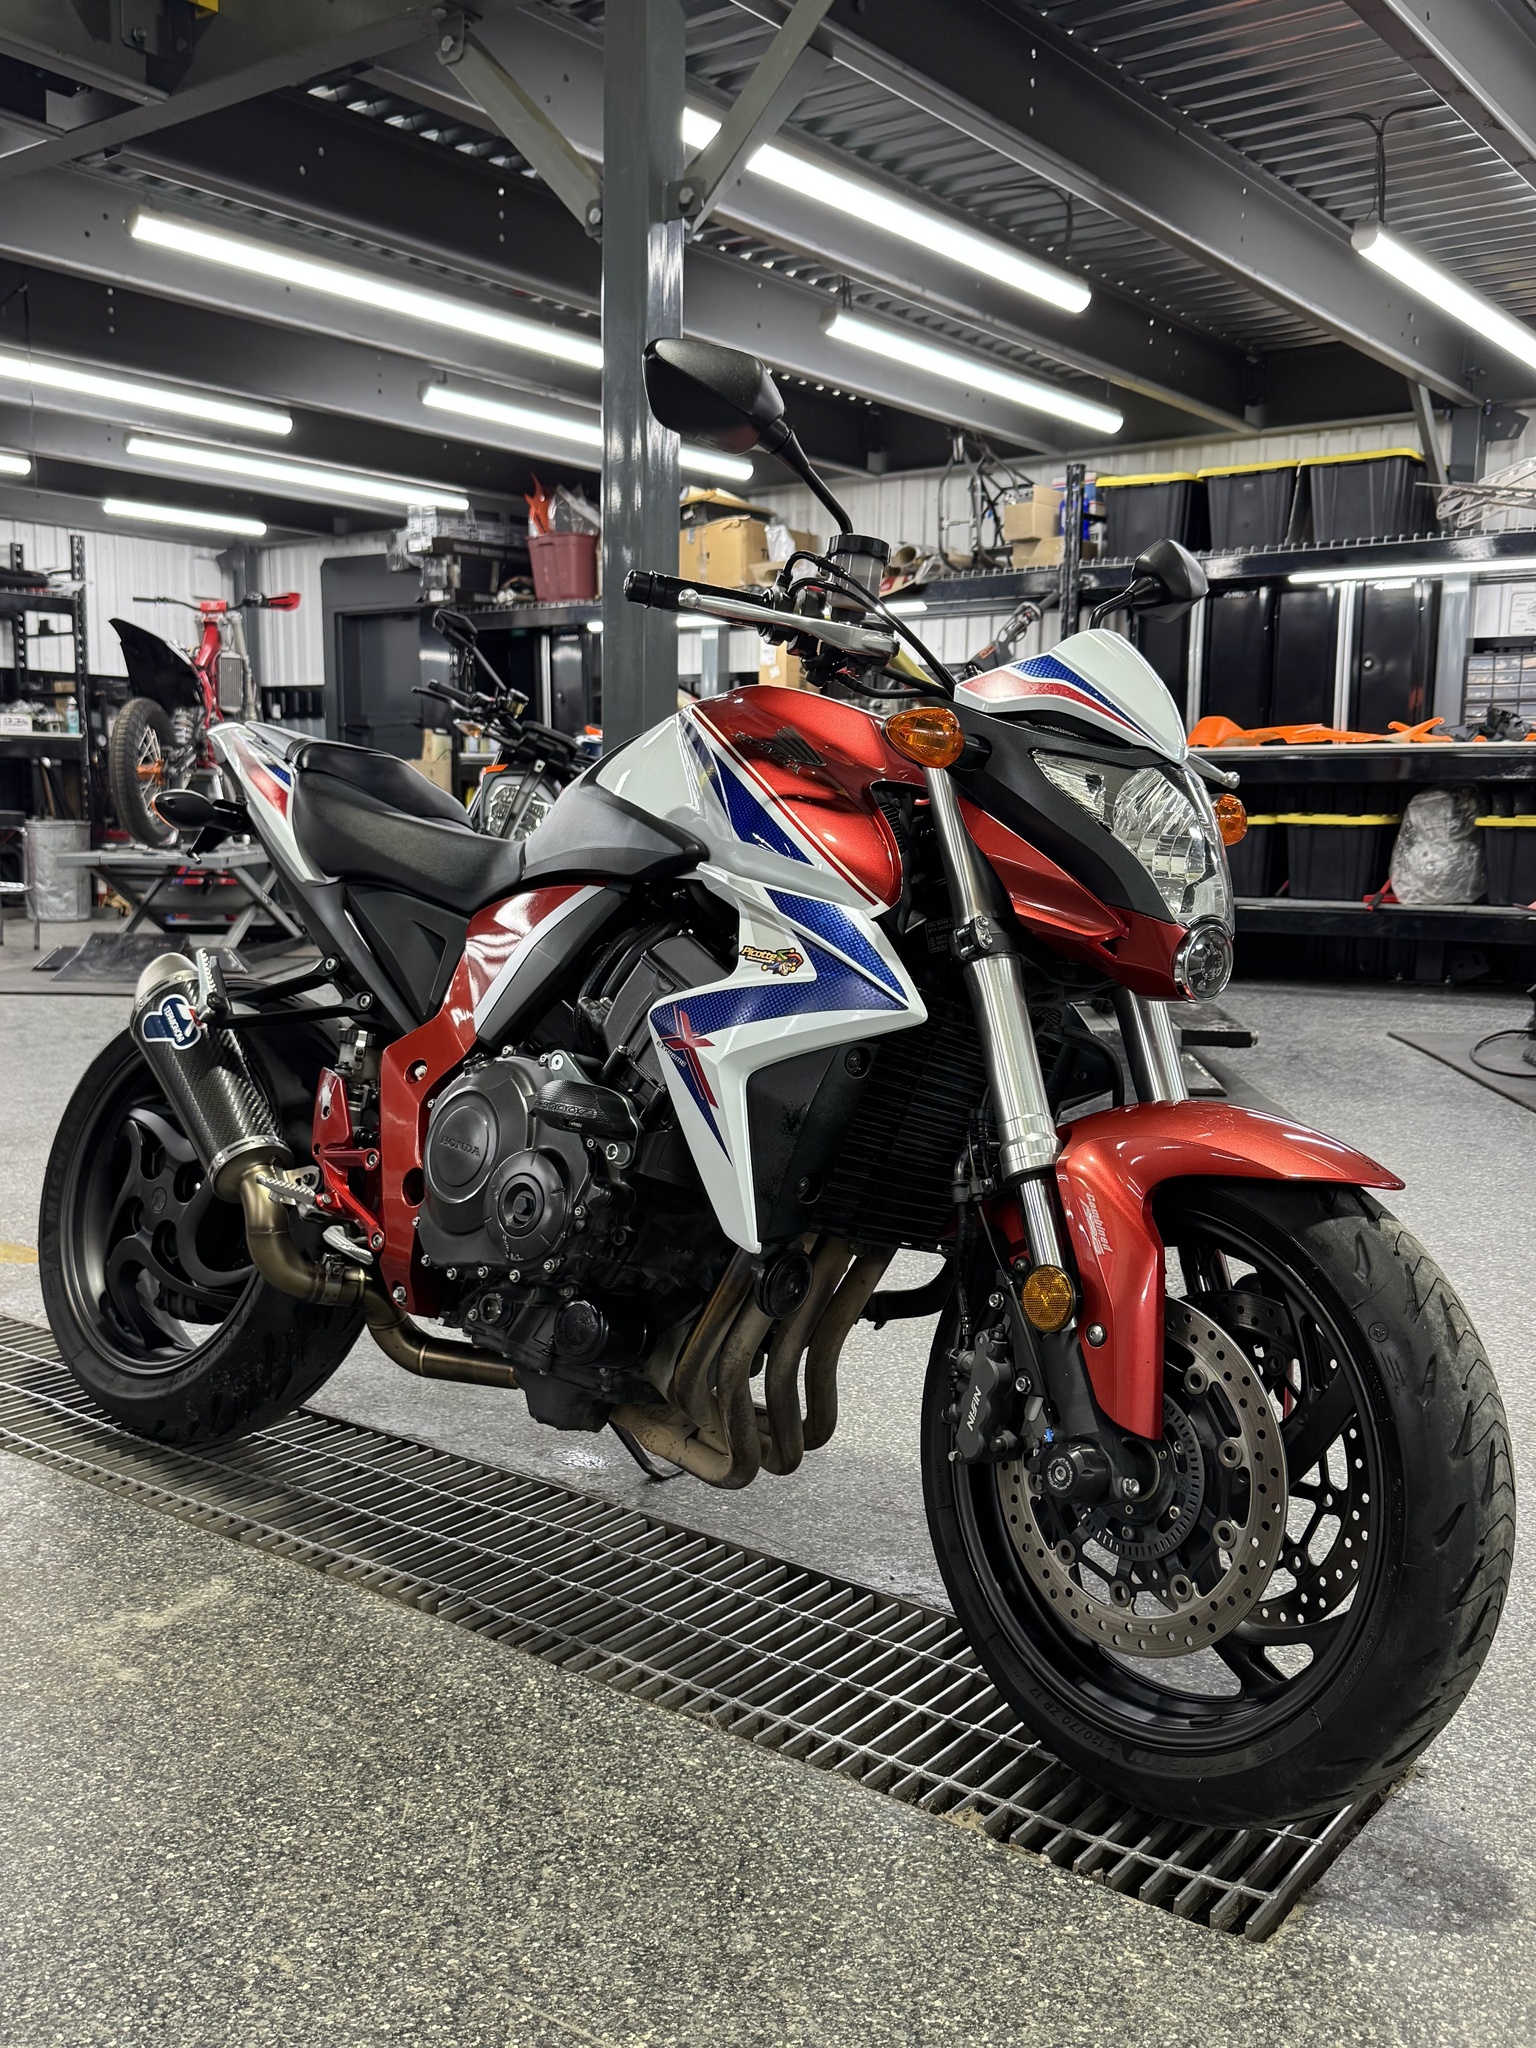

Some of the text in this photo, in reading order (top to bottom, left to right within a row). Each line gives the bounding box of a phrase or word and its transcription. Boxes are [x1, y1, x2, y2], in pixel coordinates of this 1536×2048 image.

[164, 1004, 185, 1043] TERMIGNONI
[440, 1135, 481, 1157] HONDA
[1086, 1193, 1113, 1252] Combined
[967, 1385, 982, 1432] NISSIN
[1029, 1688, 1105, 1748] 120/70 ZR 17
